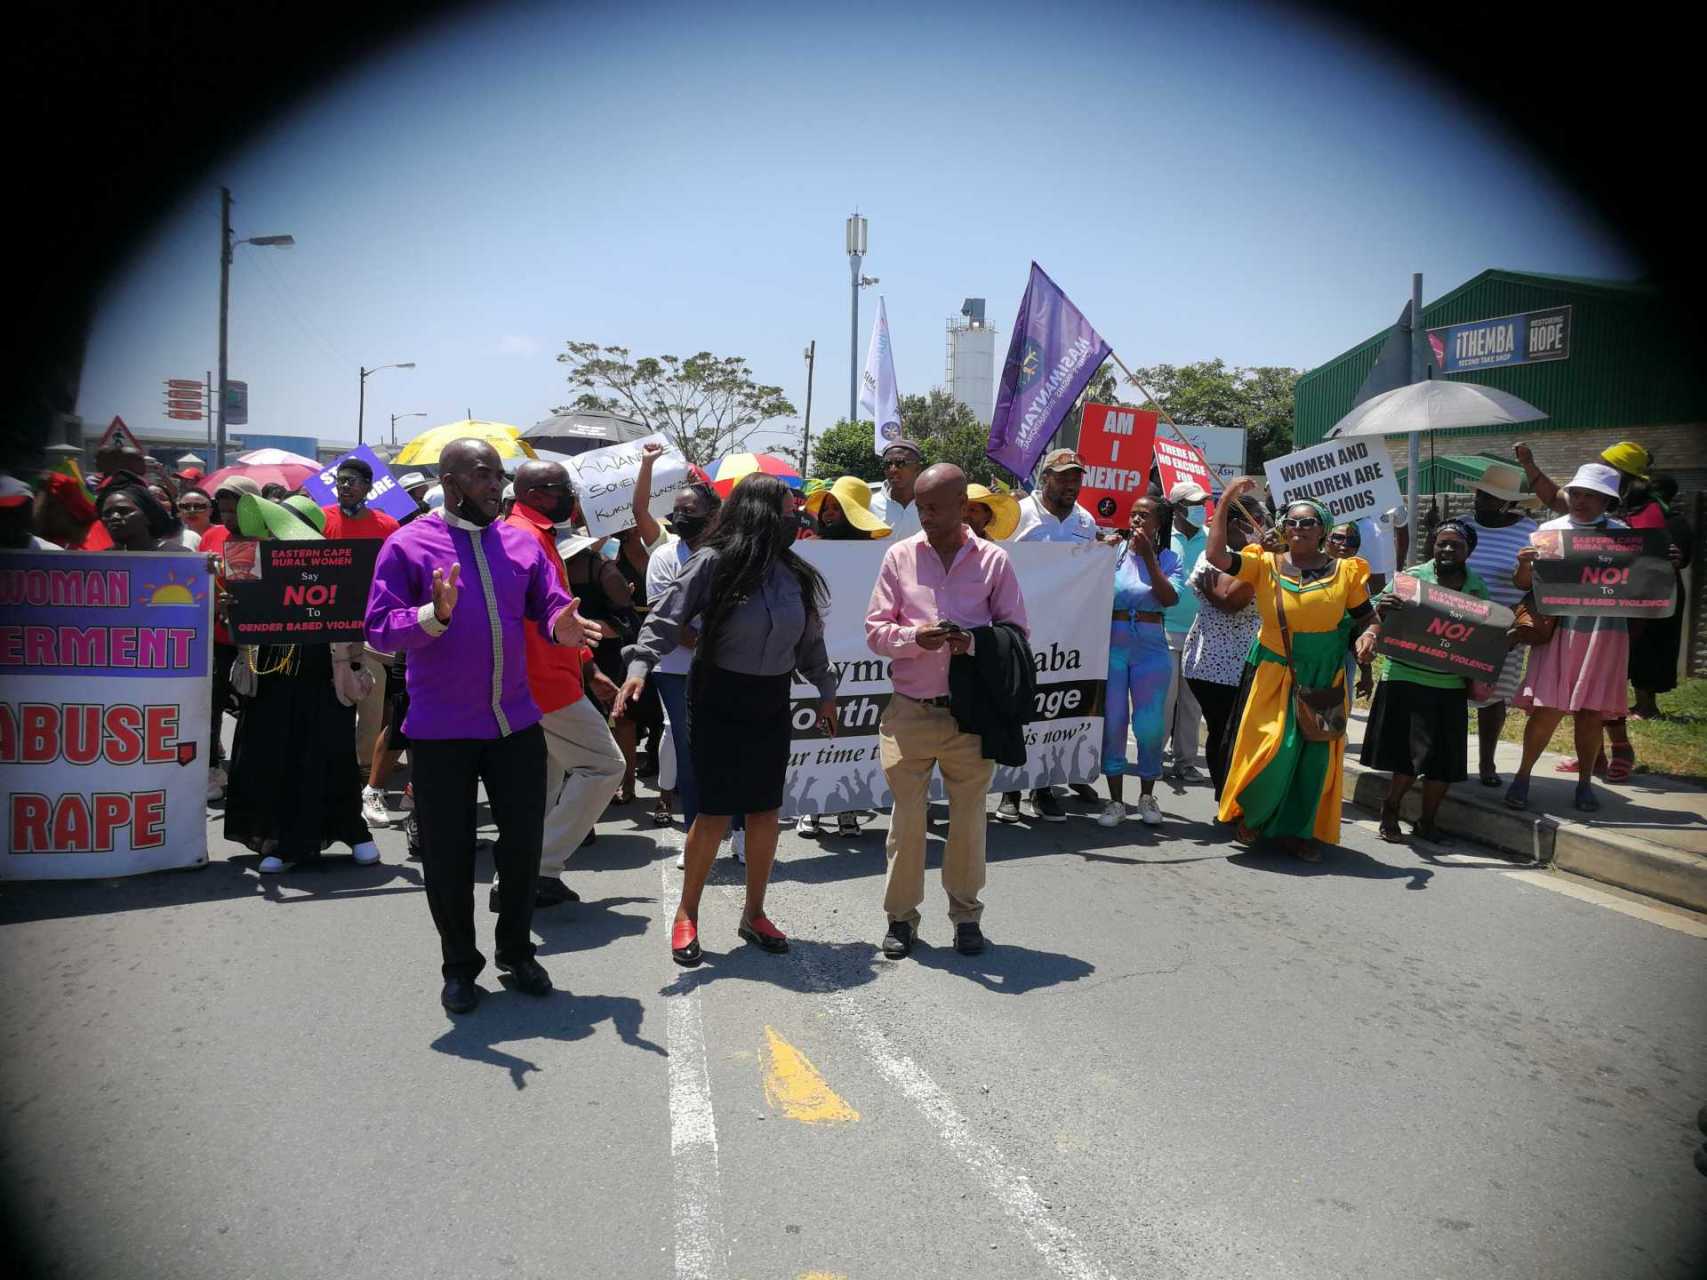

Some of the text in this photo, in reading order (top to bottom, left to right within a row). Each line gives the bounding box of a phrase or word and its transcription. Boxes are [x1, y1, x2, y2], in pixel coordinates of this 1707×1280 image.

[1456, 323, 1514, 359] iTHEMBA
[1529, 323, 1563, 352] HOPE
[1103, 410, 1135, 435] AM
[1111, 440, 1120, 462] I
[1159, 441, 1189, 459] THERE
[1158, 453, 1207, 476] NO EXCUSE
[1280, 442, 1368, 482] WOMEN AND
[1081, 465, 1141, 492] NEXT?
[1283, 462, 1384, 504] CHILDREN ARE
[1328, 489, 1375, 517] CIOUS
[271, 548, 352, 559] EASTERN CAPE
[272, 557, 352, 567] RURAL WOMEN
[301, 571, 319, 581] Say
[1580, 566, 1630, 585] NO!
[0, 570, 130, 607] WOMAN
[283, 584, 337, 606] NO!
[1600, 586, 1615, 595] To
[306, 607, 321, 617] To
[1619, 599, 1671, 609] VIOLENCE
[238, 620, 364, 632] GENDER BASED VIOLEN
[1426, 618, 1475, 642] NO!
[0, 626, 196, 669] ERMENT
[1440, 638, 1451, 648] To
[1034, 642, 1082, 673] aba
[1034, 689, 1082, 719] nge
[788, 752, 811, 767] ur
[816, 744, 865, 765] time
[9, 789, 166, 854] RAPE
